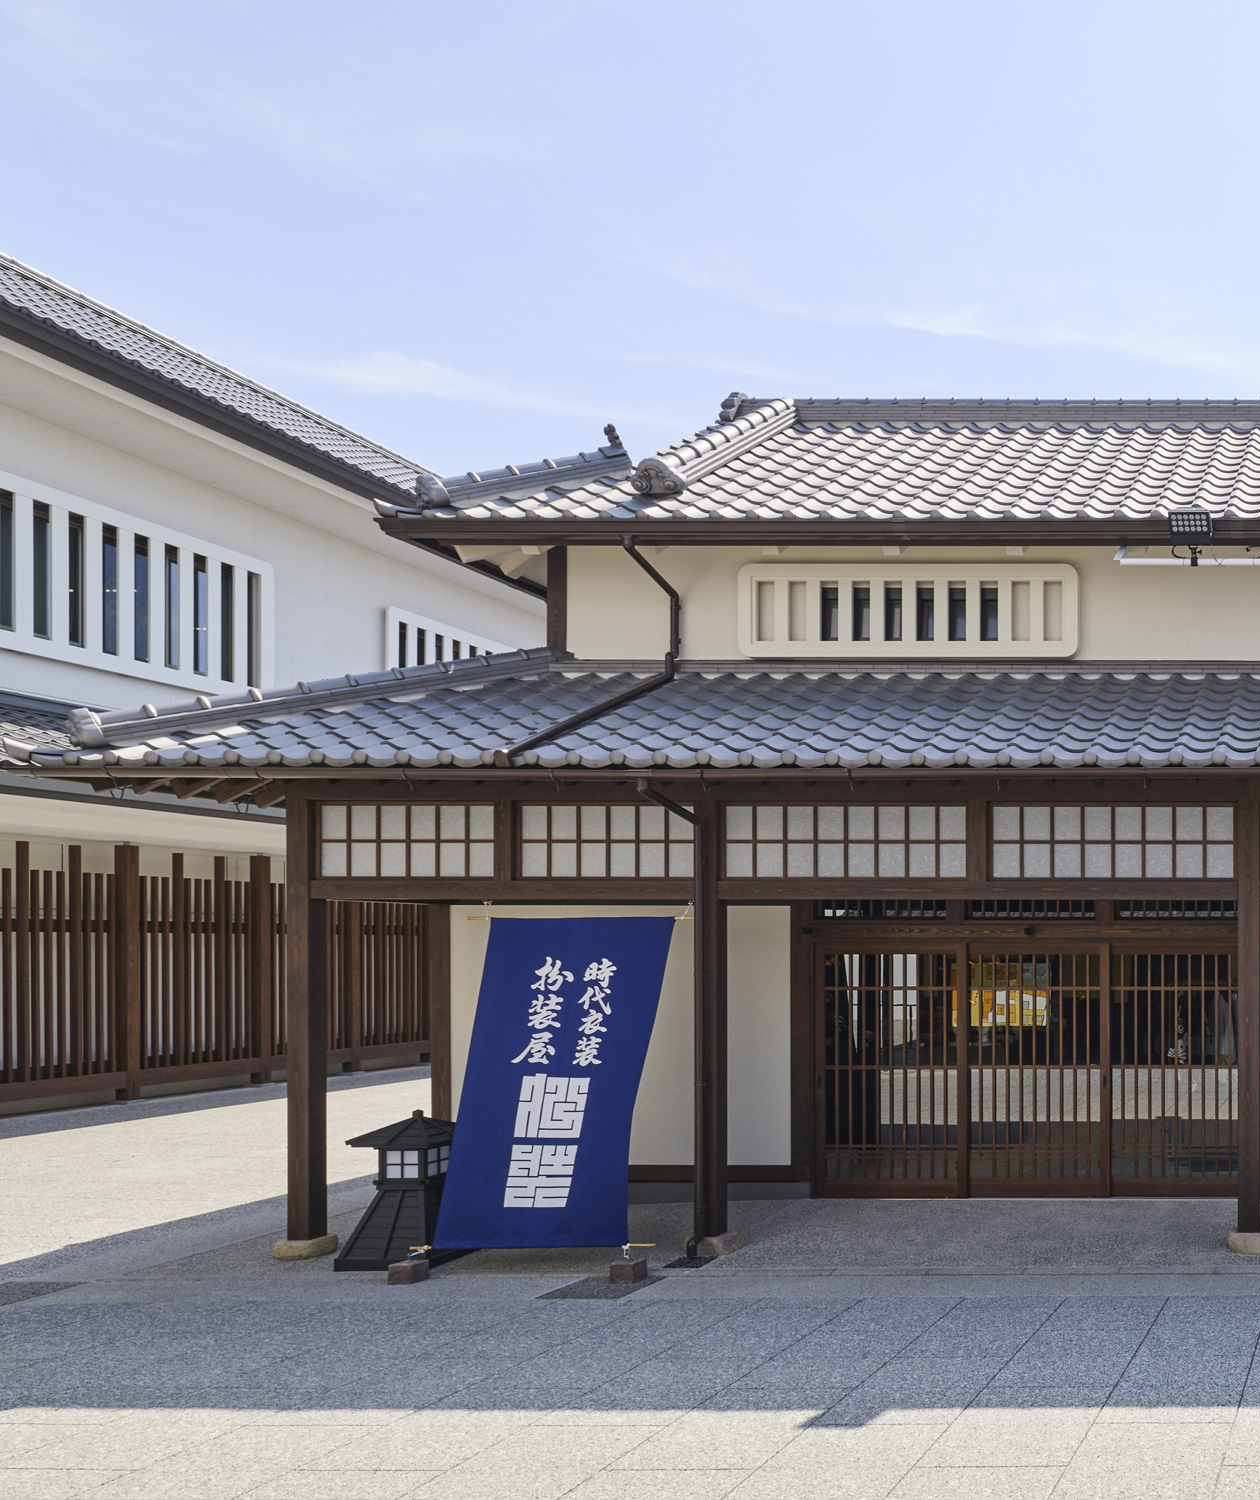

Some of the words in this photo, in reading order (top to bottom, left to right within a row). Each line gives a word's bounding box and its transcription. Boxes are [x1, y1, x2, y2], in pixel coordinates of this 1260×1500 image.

[511, 956, 575, 1065] 扮装屋
[572, 958, 618, 1066] 時代衣装
